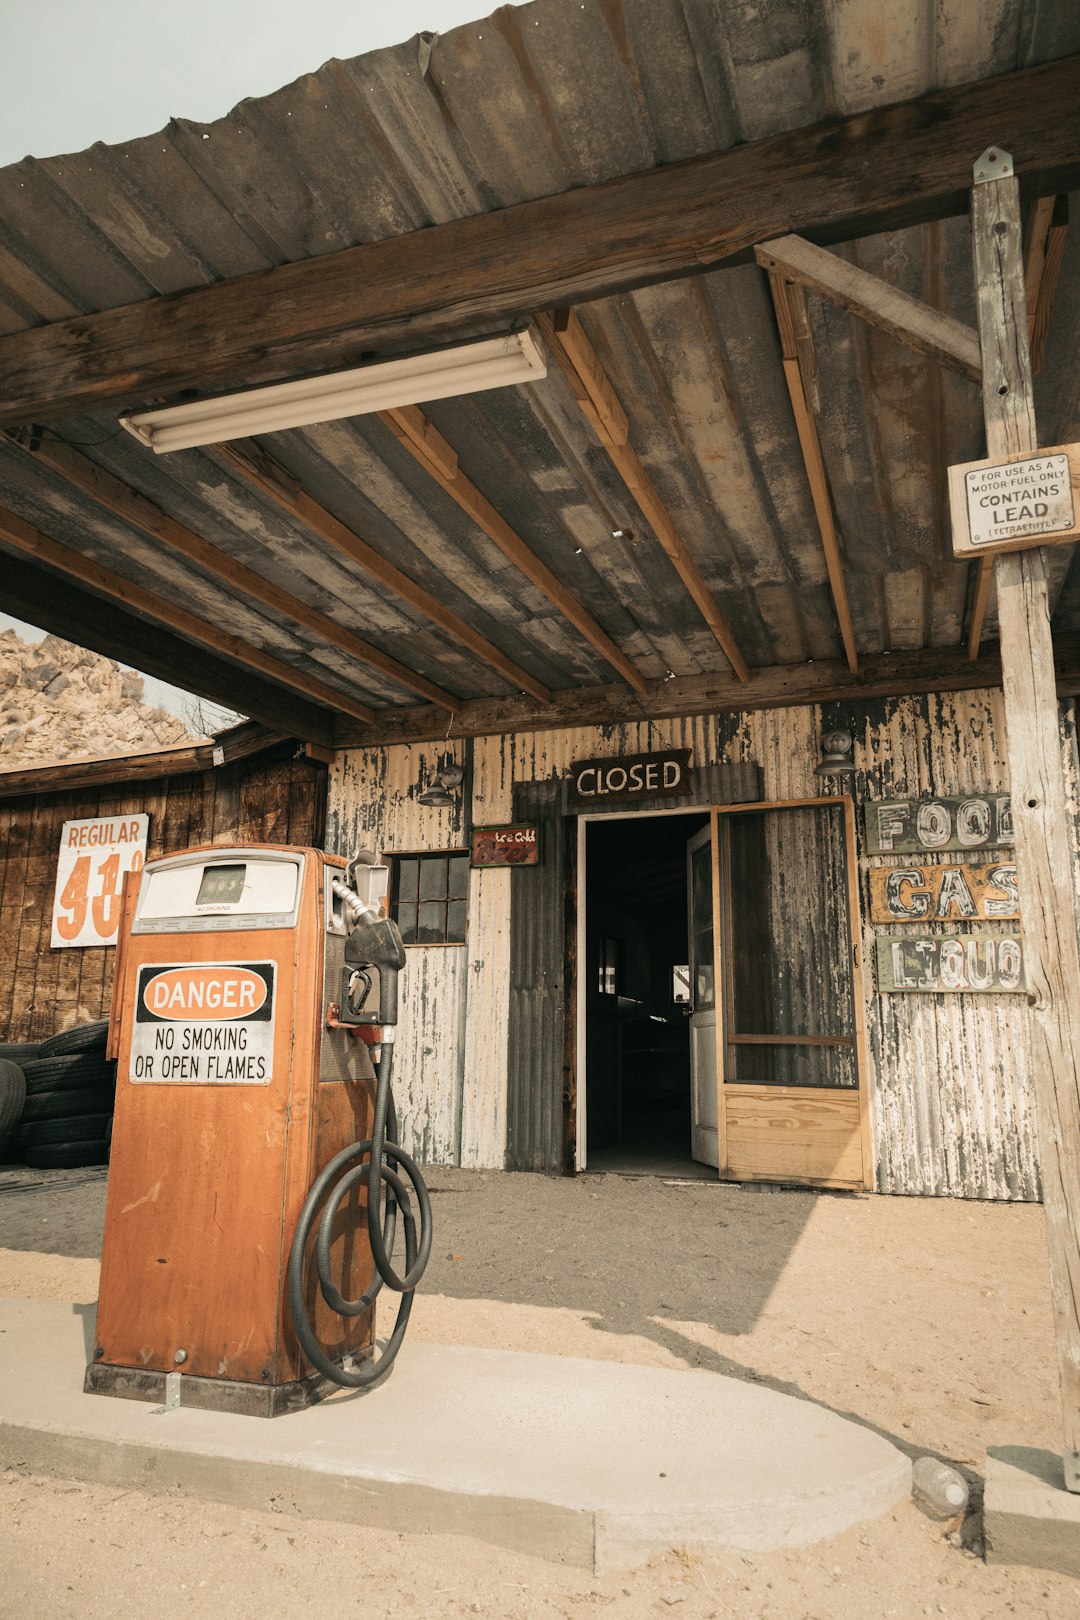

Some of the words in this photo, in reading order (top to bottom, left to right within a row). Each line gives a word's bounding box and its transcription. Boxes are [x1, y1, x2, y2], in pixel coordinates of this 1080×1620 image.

[972, 480, 1007, 494] MOTOR
[1011, 475, 1036, 486] FUEL
[1040, 470, 1065, 481] ONLY
[981, 471, 1001, 481] FOR
[1005, 467, 1025, 477] USE
[1028, 464, 1042, 473] AS
[979, 484, 1060, 508] CONTAINS
[992, 502, 1049, 524] LEAD
[576, 761, 681, 797] CLOSED
[68, 821, 140, 848] REGULAR
[515, 829, 536, 843] Cold
[886, 865, 1019, 918] GAS
[153, 980, 256, 1009] DANGER
[155, 1028, 175, 1050] NO
[182, 1028, 248, 1050] SMOKING
[135, 1055, 154, 1078] OR
[161, 1056, 200, 1079] OPEN
[207, 1056, 266, 1079] FLAMES
